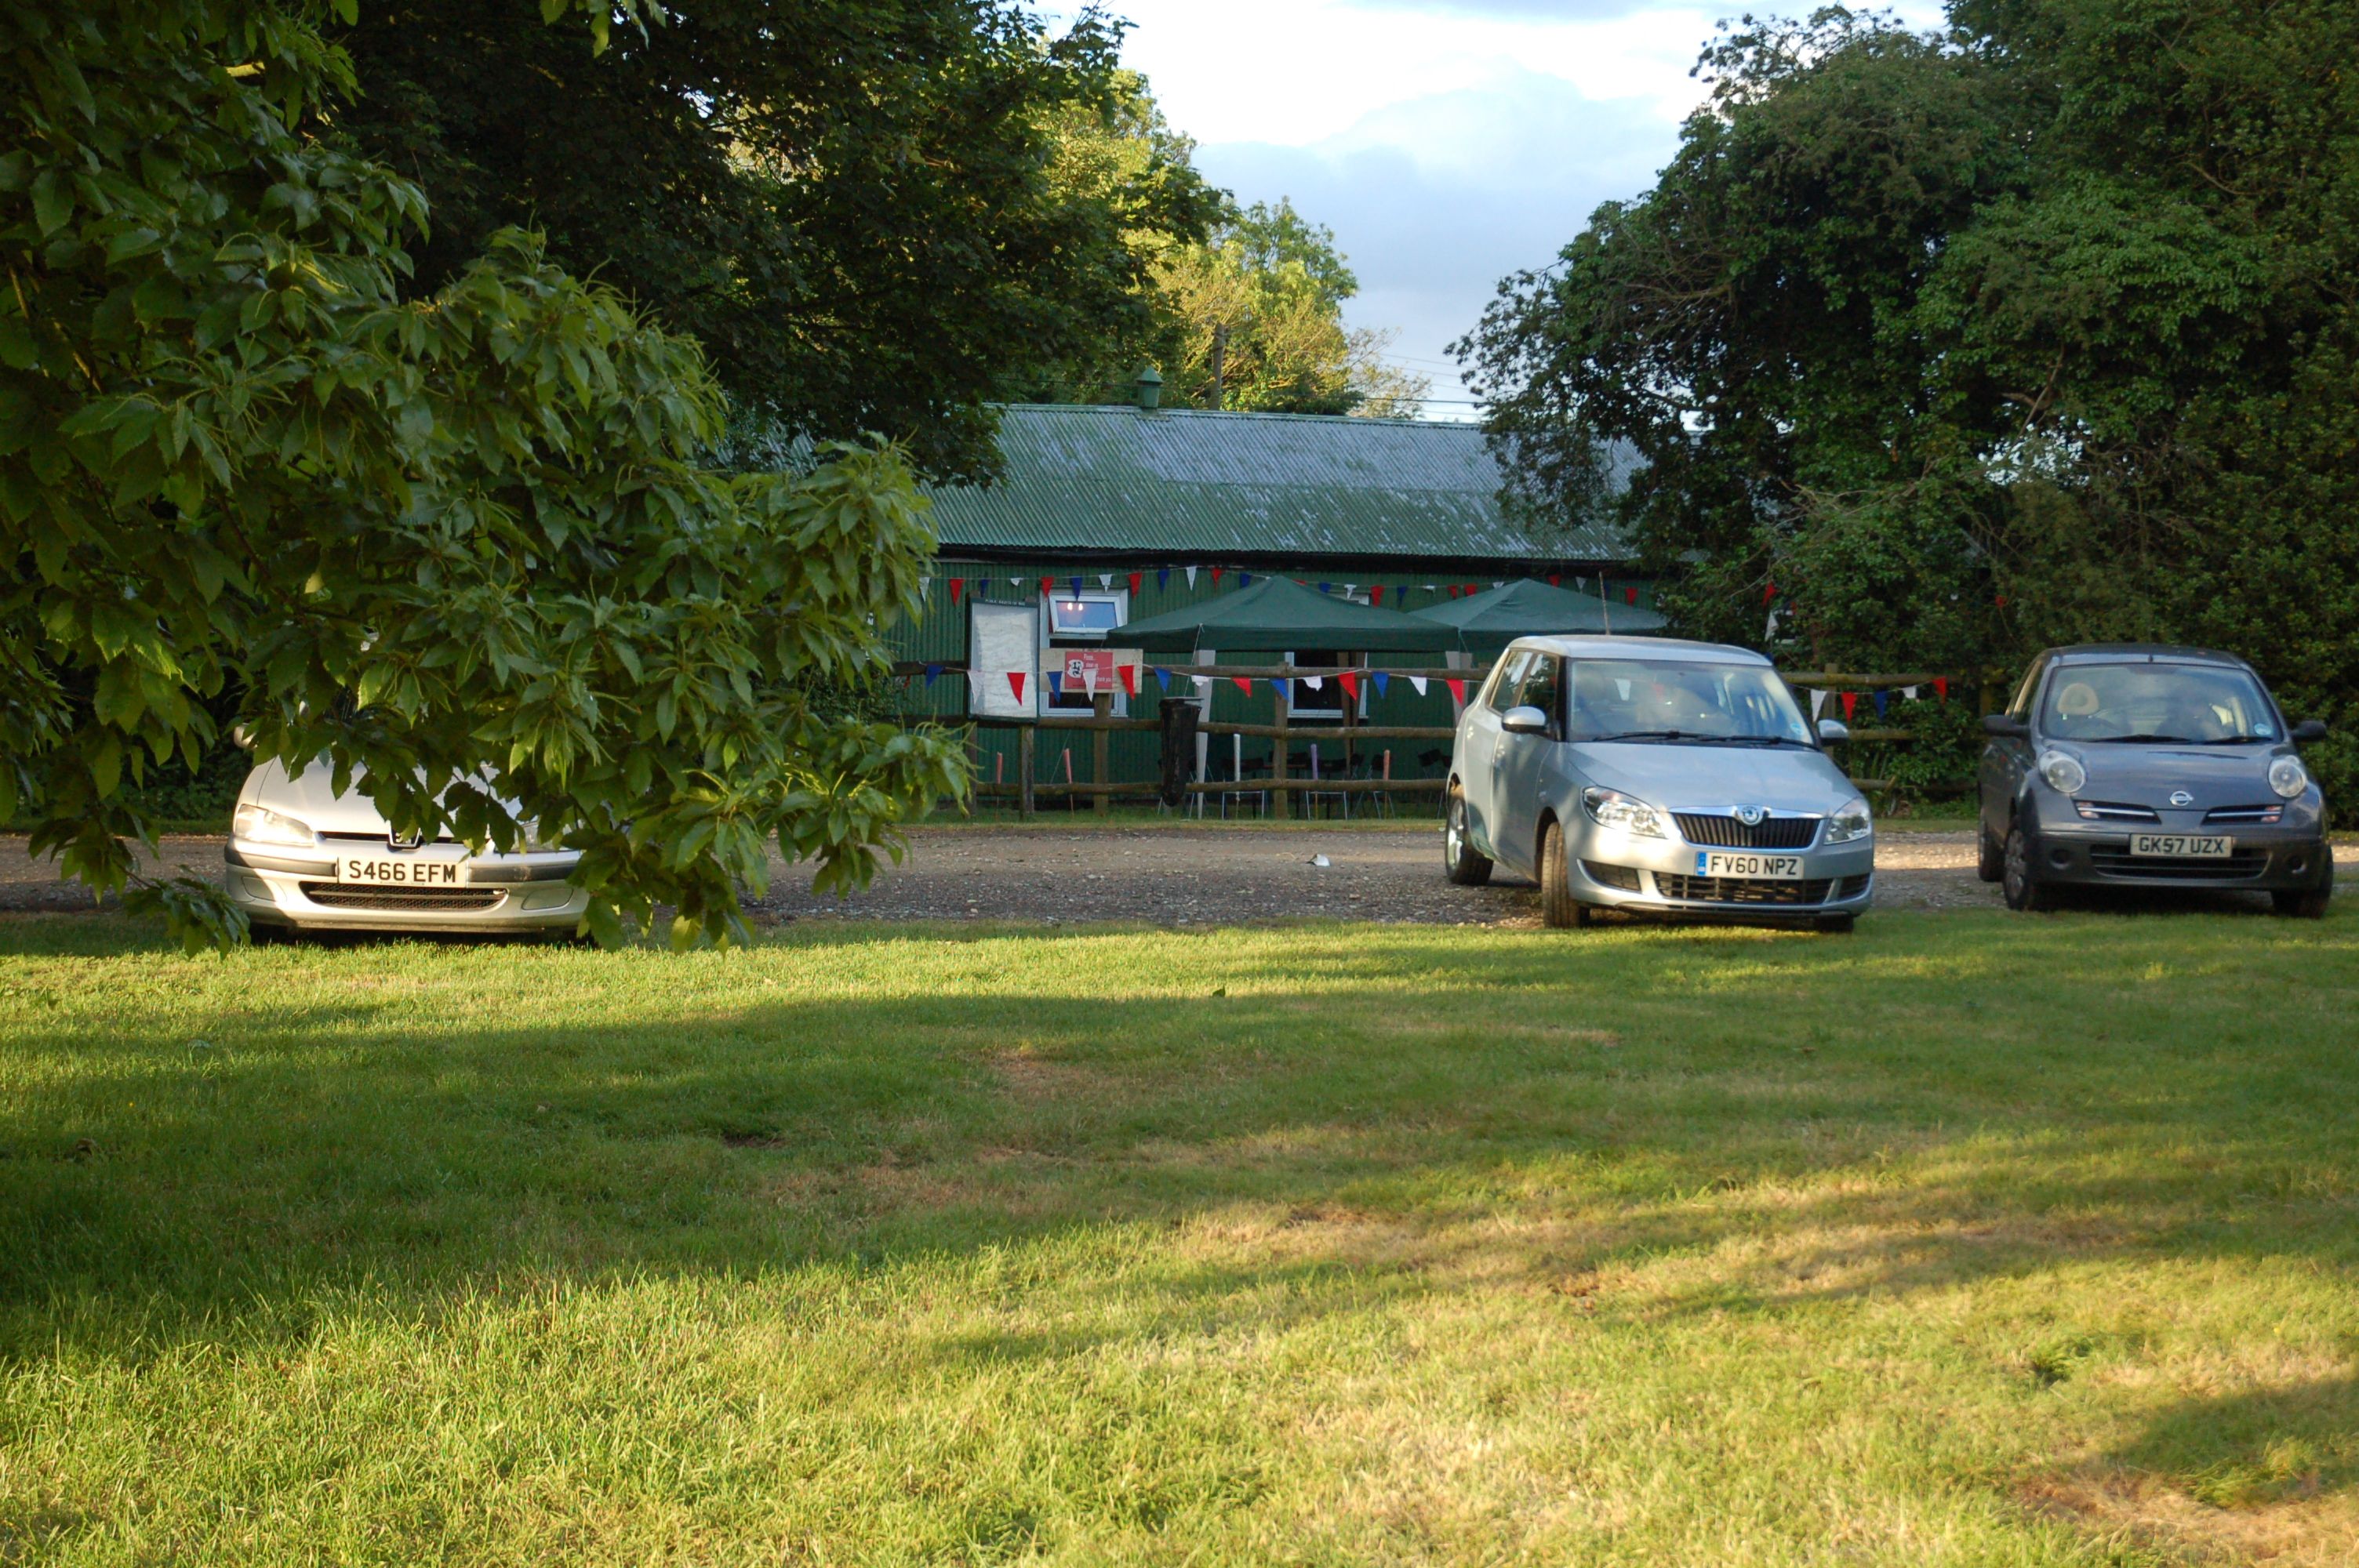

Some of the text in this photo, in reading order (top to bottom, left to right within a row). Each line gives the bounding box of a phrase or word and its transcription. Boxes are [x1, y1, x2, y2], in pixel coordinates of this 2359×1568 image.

[2139, 837, 2224, 854] GK57 UZX
[349, 860, 456, 884] S466 EFM
[1710, 855, 1797, 876] FV60 NPZ
